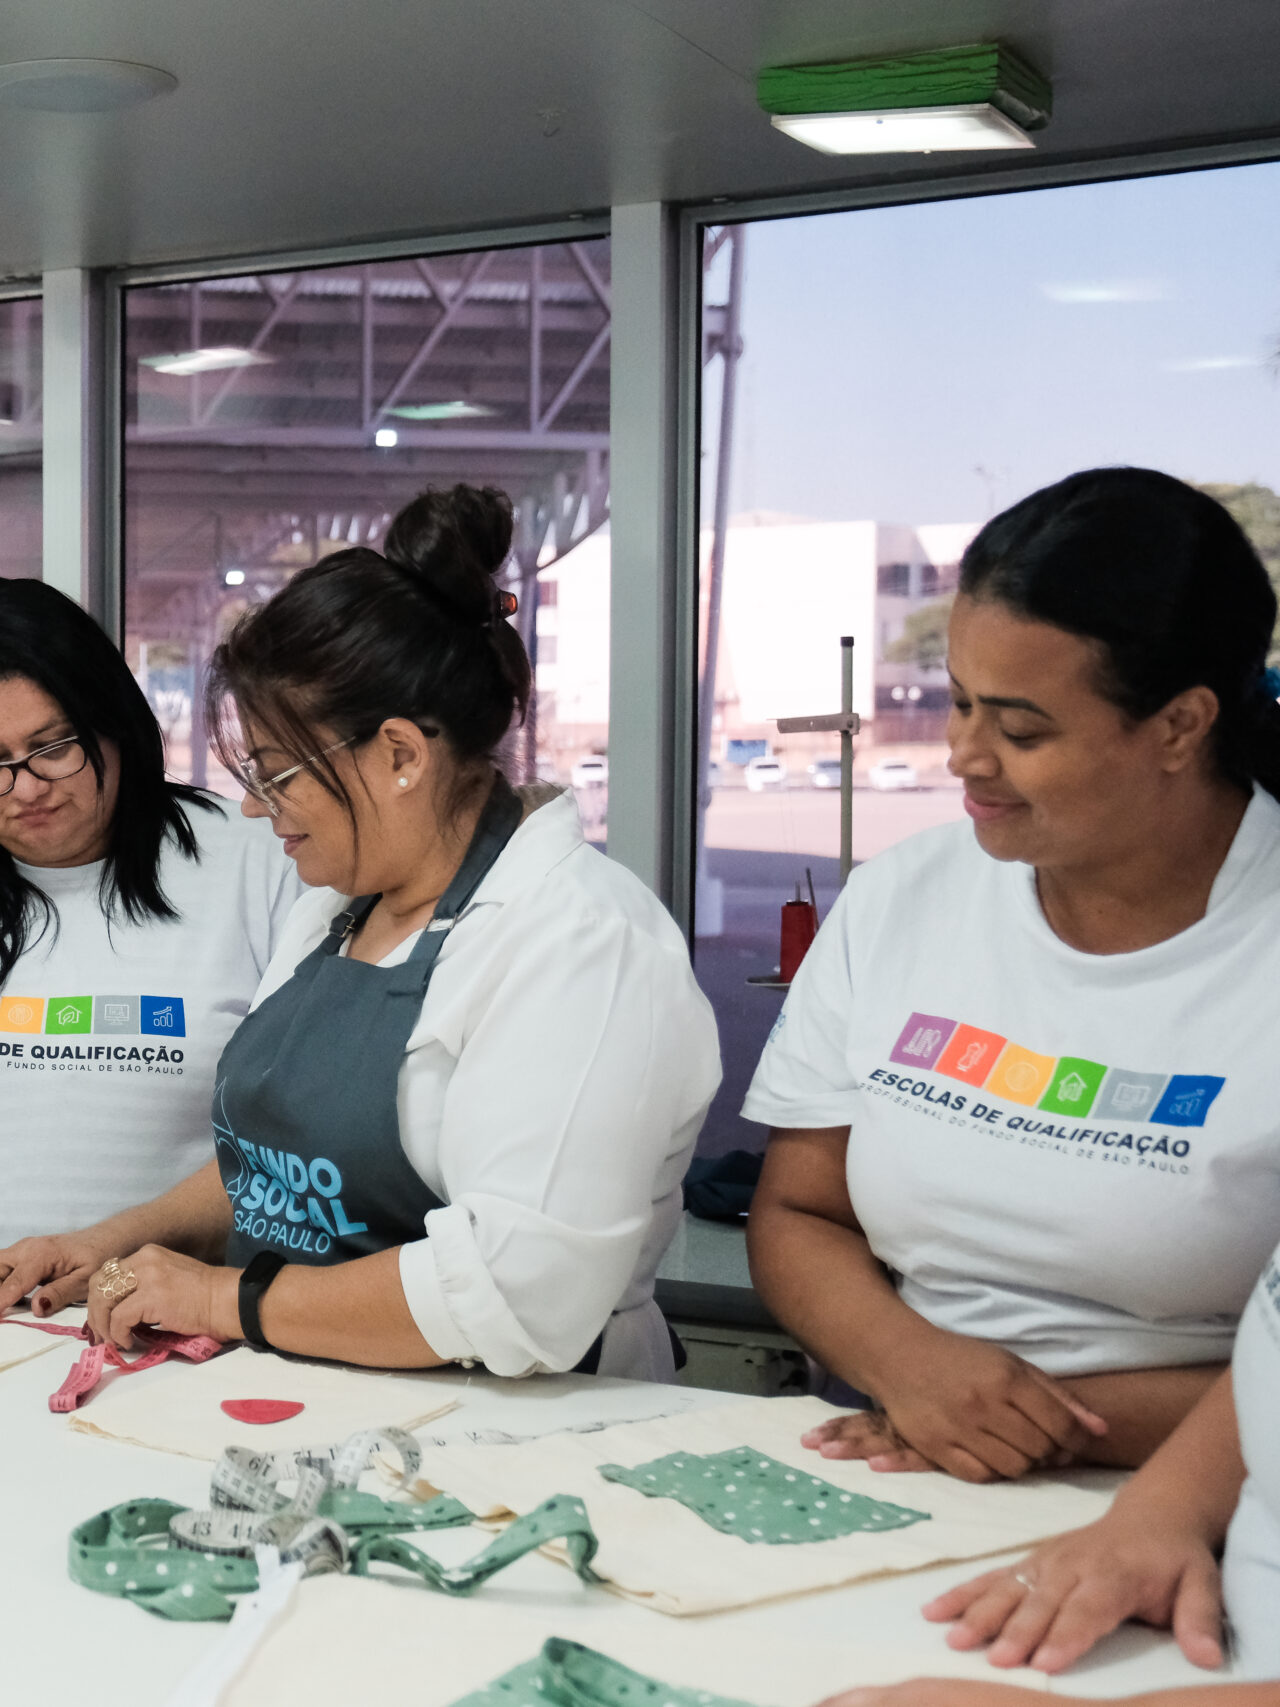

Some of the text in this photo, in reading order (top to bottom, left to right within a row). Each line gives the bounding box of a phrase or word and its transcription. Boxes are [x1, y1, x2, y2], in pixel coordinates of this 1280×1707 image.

[7, 1061, 45, 1071] FUNDO
[51, 1063, 92, 1072] SOCIAL
[98, 1064, 113, 1072] DE
[119, 1063, 141, 1073] SÃO
[148, 1066, 184, 1075] PAULO
[30, 1044, 184, 1064] QUALIFICAÇÃO
[859, 1082, 942, 1121] PROFISSIONAL
[948, 1115, 967, 1128] DO
[1019, 1137, 1068, 1154] SOCIAL
[1076, 1148, 1095, 1160] DE
[1102, 1151, 1131, 1165] SÃO
[1138, 1158, 1189, 1175] PAULO
[869, 1068, 1190, 1158] ESCOLAS DE QUALIFICAÇÃO
[237, 1138, 342, 1198] FUNDO
[234, 1210, 331, 1254] SÃO PAULO
